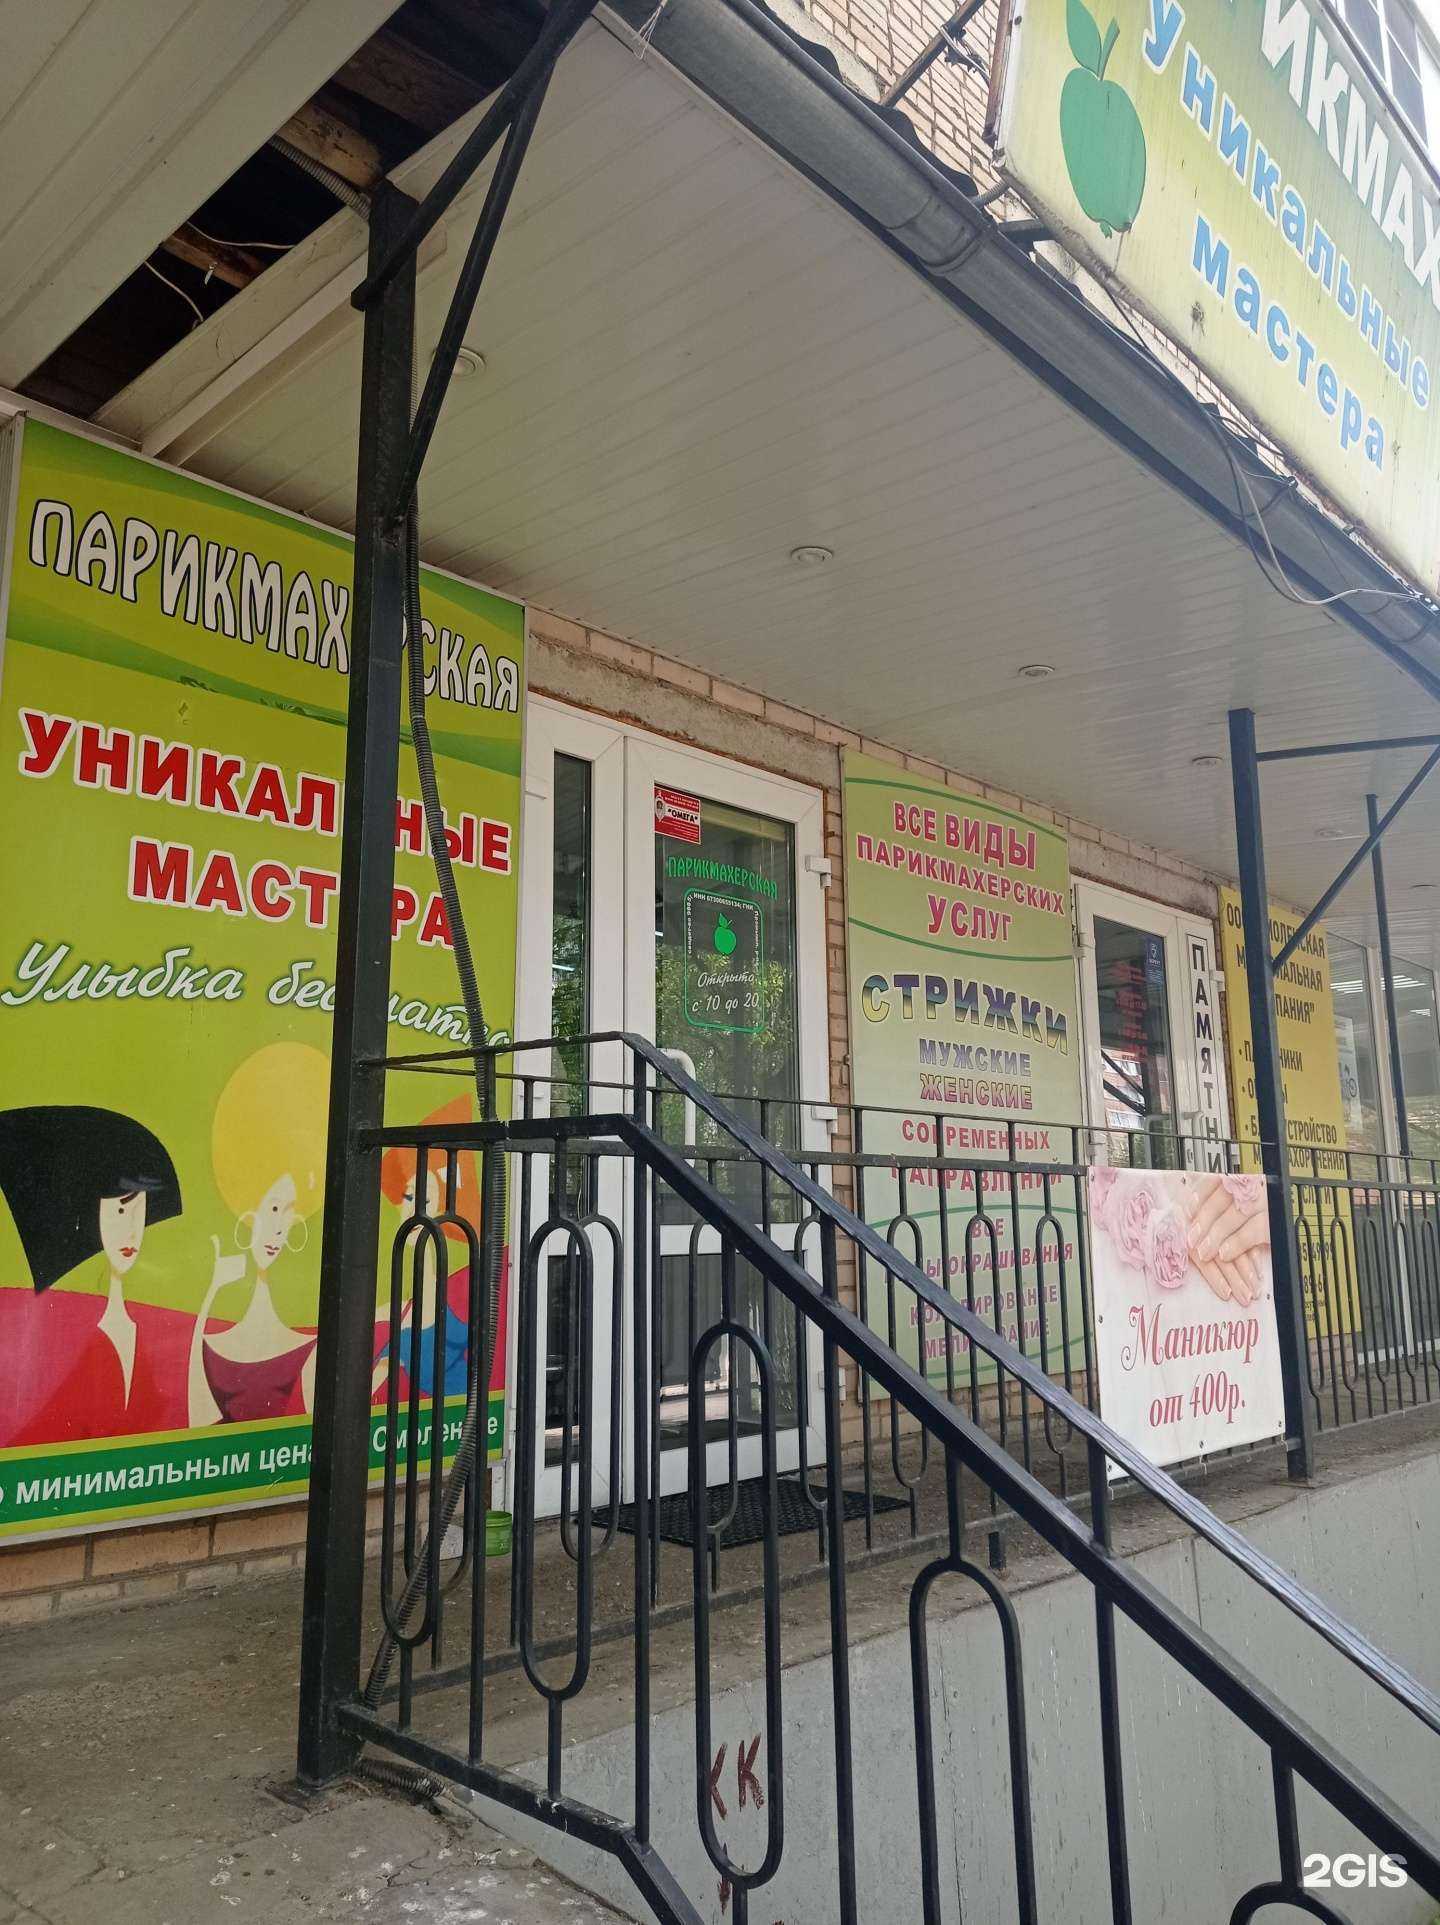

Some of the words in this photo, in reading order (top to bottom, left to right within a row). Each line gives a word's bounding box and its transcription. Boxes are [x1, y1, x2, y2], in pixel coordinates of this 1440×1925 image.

[1261, 0, 1440, 314] ИКМАХ
[29, 499, 519, 712] ПАРИКМАХСКАЯ
[19, 706, 511, 874] УНИКАЛНЫЕ
[894, 801, 937, 842] ВСЕ
[945, 813, 1036, 870] ВИДЫ
[128, 835, 458, 949] МАСТРА
[667, 856, 778, 899] ПАРИКМАХЕРСКАЯ
[856, 834, 1065, 915] ПАРИКМАХЕРСКИХ
[927, 894, 1012, 941] УСЛУГ
[1226, 902, 1244, 930] ОО
[1, 941, 244, 1005] Улыбка
[706, 995, 721, 1011] 10
[744, 993, 760, 1008] 20
[861, 973, 1069, 1056] СТРИЖКИ
[919, 1038, 1032, 1077] МУЖСКИЕ
[919, 1072, 1033, 1110] ЖЕНСКИЕ
[1121, 1303, 1259, 1371] Маникюр
[1150, 1395, 1184, 1427] от
[16, 1451, 250, 1504] минимальным
